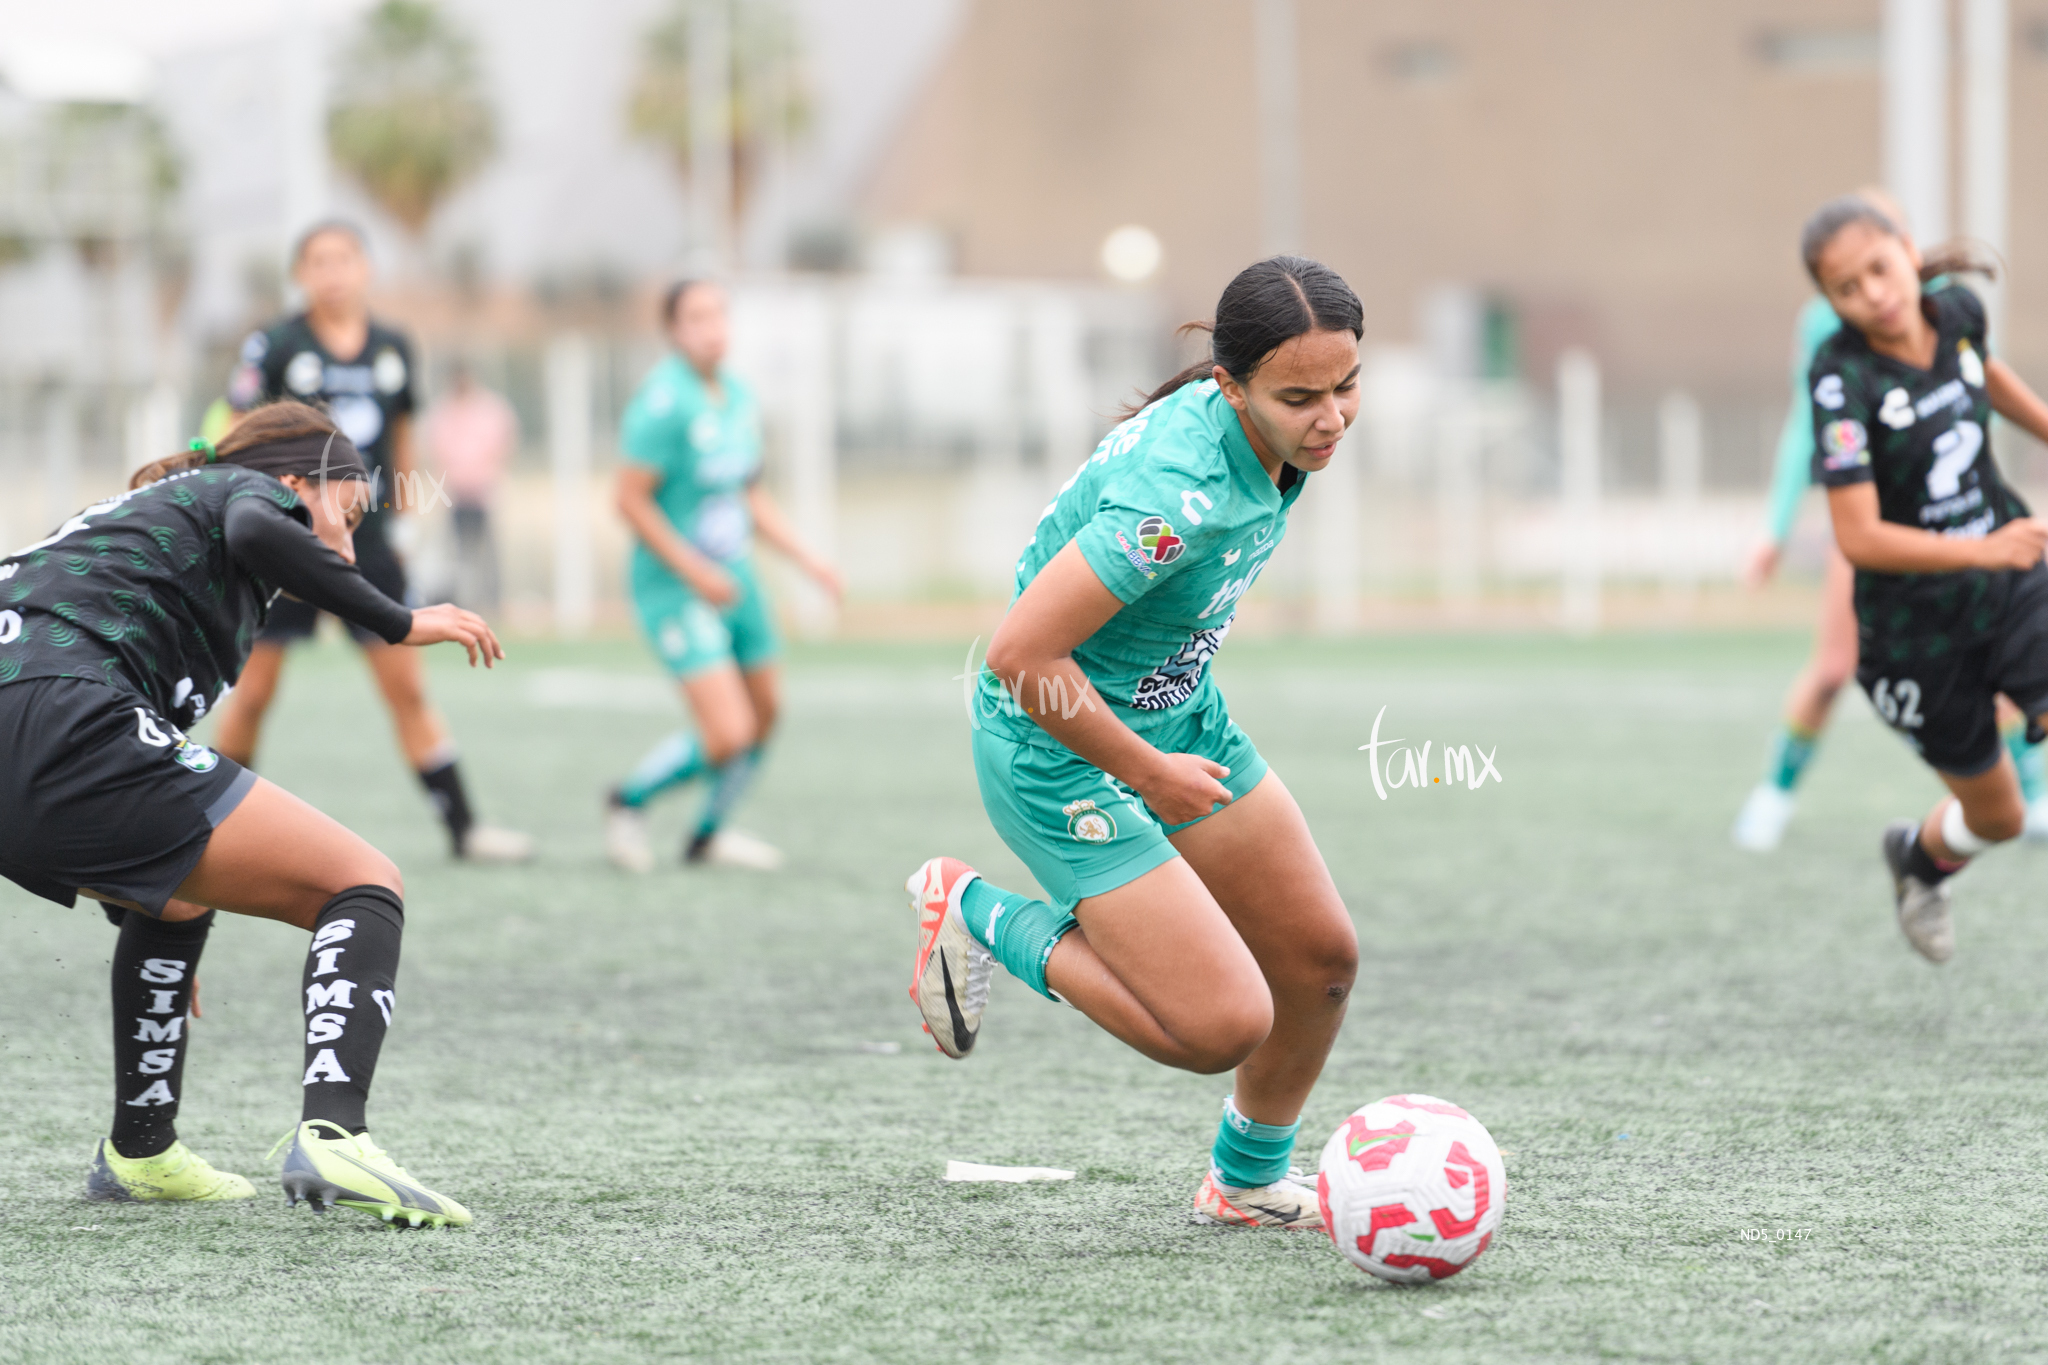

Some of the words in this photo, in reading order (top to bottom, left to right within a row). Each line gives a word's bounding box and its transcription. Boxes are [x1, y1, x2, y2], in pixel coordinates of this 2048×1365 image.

[1873, 677, 1924, 729] 62
[125, 958, 187, 1107] SIMSA
[302, 918, 358, 1086] SIMSA
